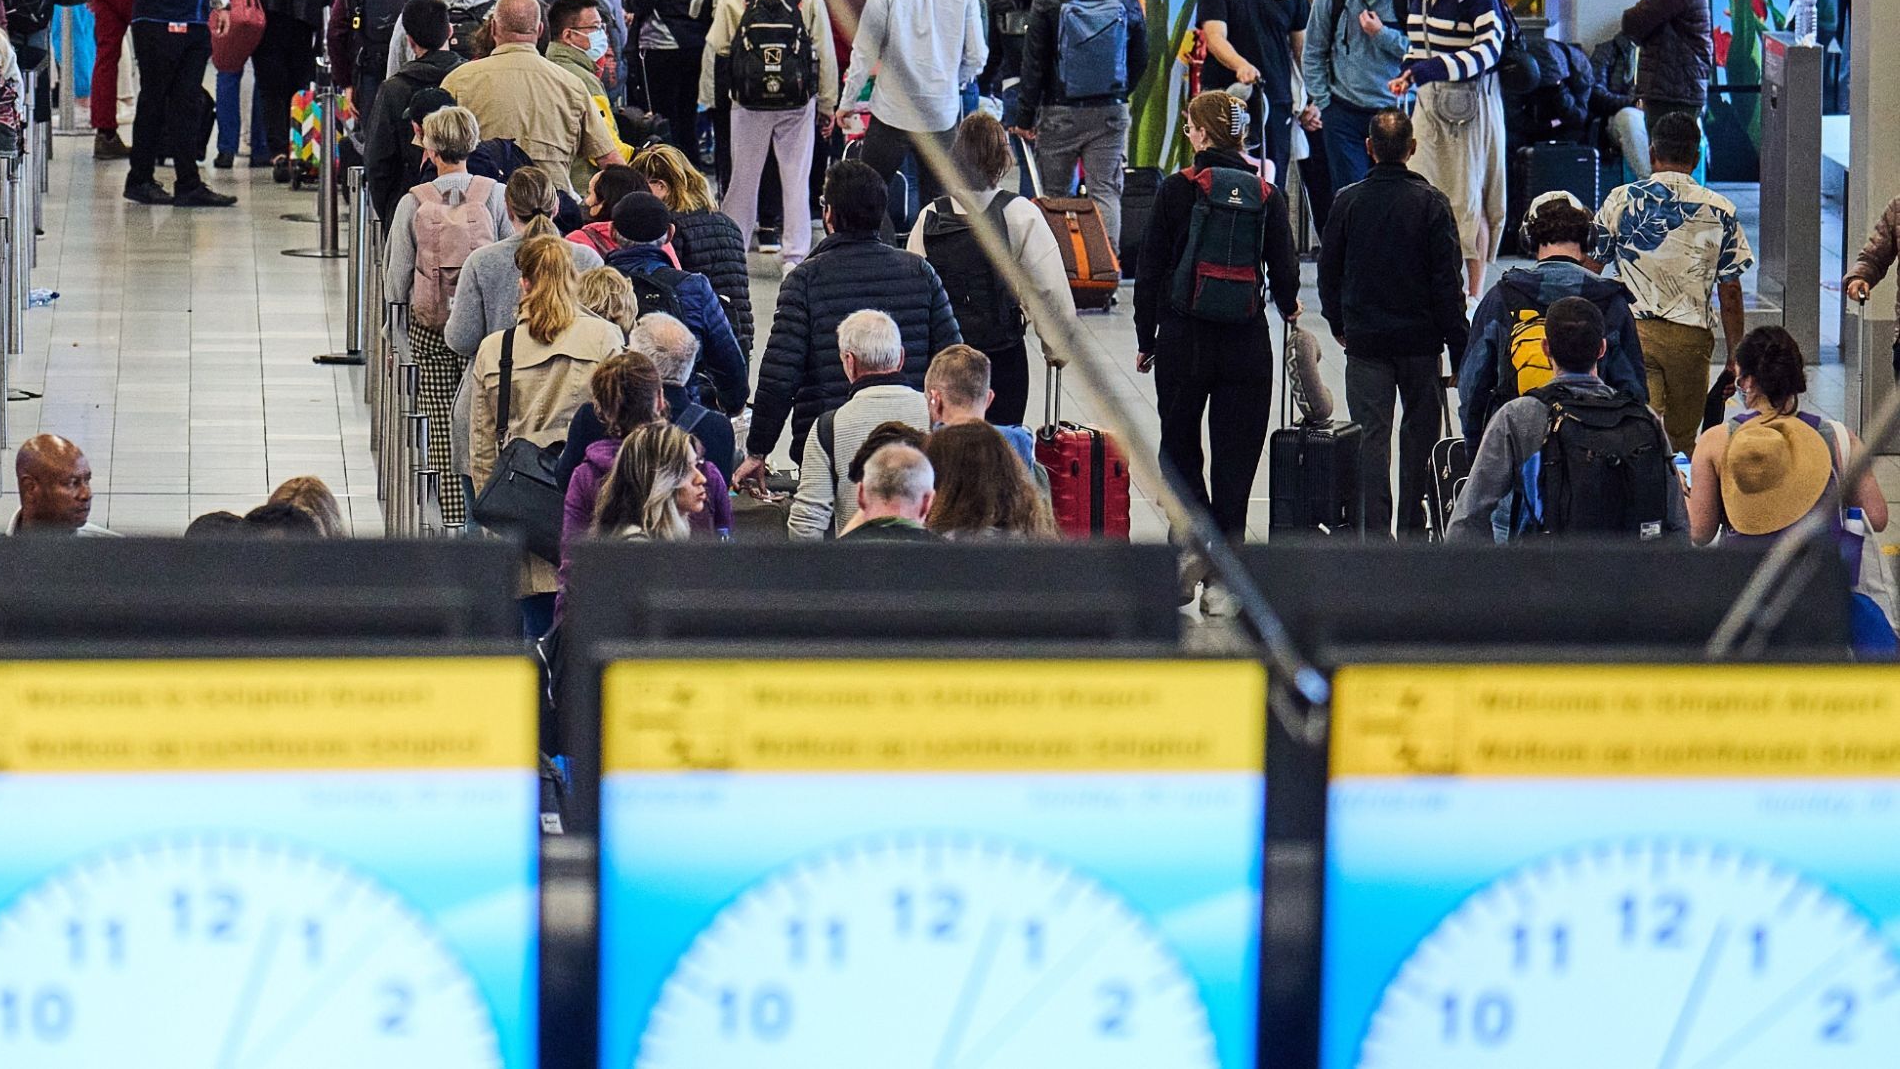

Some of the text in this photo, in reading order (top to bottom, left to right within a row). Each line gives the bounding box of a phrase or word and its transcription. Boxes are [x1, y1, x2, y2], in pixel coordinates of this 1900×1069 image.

[66, 917, 127, 968] 11
[173, 889, 240, 943] 12
[304, 917, 323, 967] 1
[787, 917, 847, 968] 11
[893, 888, 965, 943] 12
[1025, 917, 1044, 968] 1
[1618, 893, 1690, 948] 12
[1511, 920, 1569, 973] 11
[1751, 922, 1767, 973] 1
[0, 985, 74, 1042] 10
[379, 979, 414, 1037] 2
[719, 984, 793, 1041] 10
[1096, 979, 1134, 1037] 2
[1440, 991, 1515, 1046] 10
[1818, 988, 1858, 1044] 2
